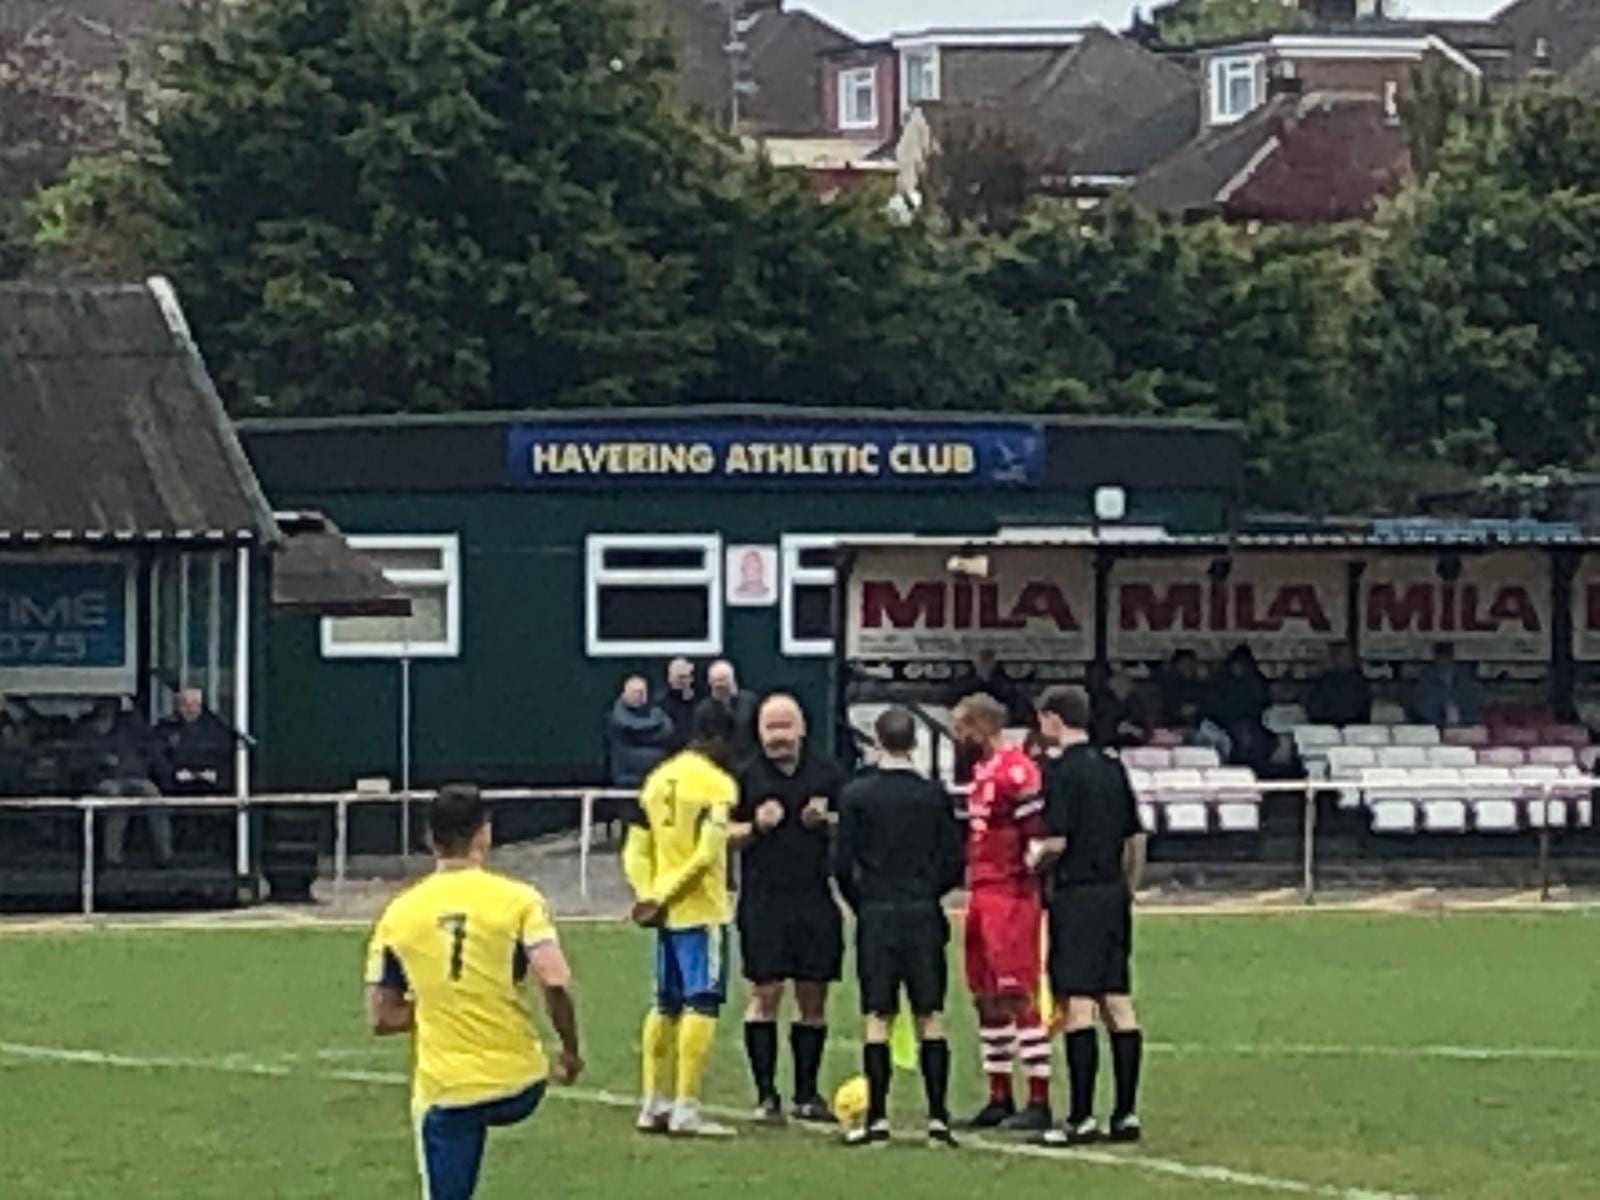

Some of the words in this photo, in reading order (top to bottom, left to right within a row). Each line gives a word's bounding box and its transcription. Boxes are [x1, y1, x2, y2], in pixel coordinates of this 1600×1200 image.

[532, 442, 716, 475] HAVERING
[725, 442, 881, 475] ATHLETIC
[889, 443, 976, 475] CLUB
[0, 590, 108, 625] IME
[861, 579, 1082, 632] MILA
[1119, 582, 1333, 633] MILA
[1365, 582, 1542, 633] MILA
[436, 912, 468, 982] 7
